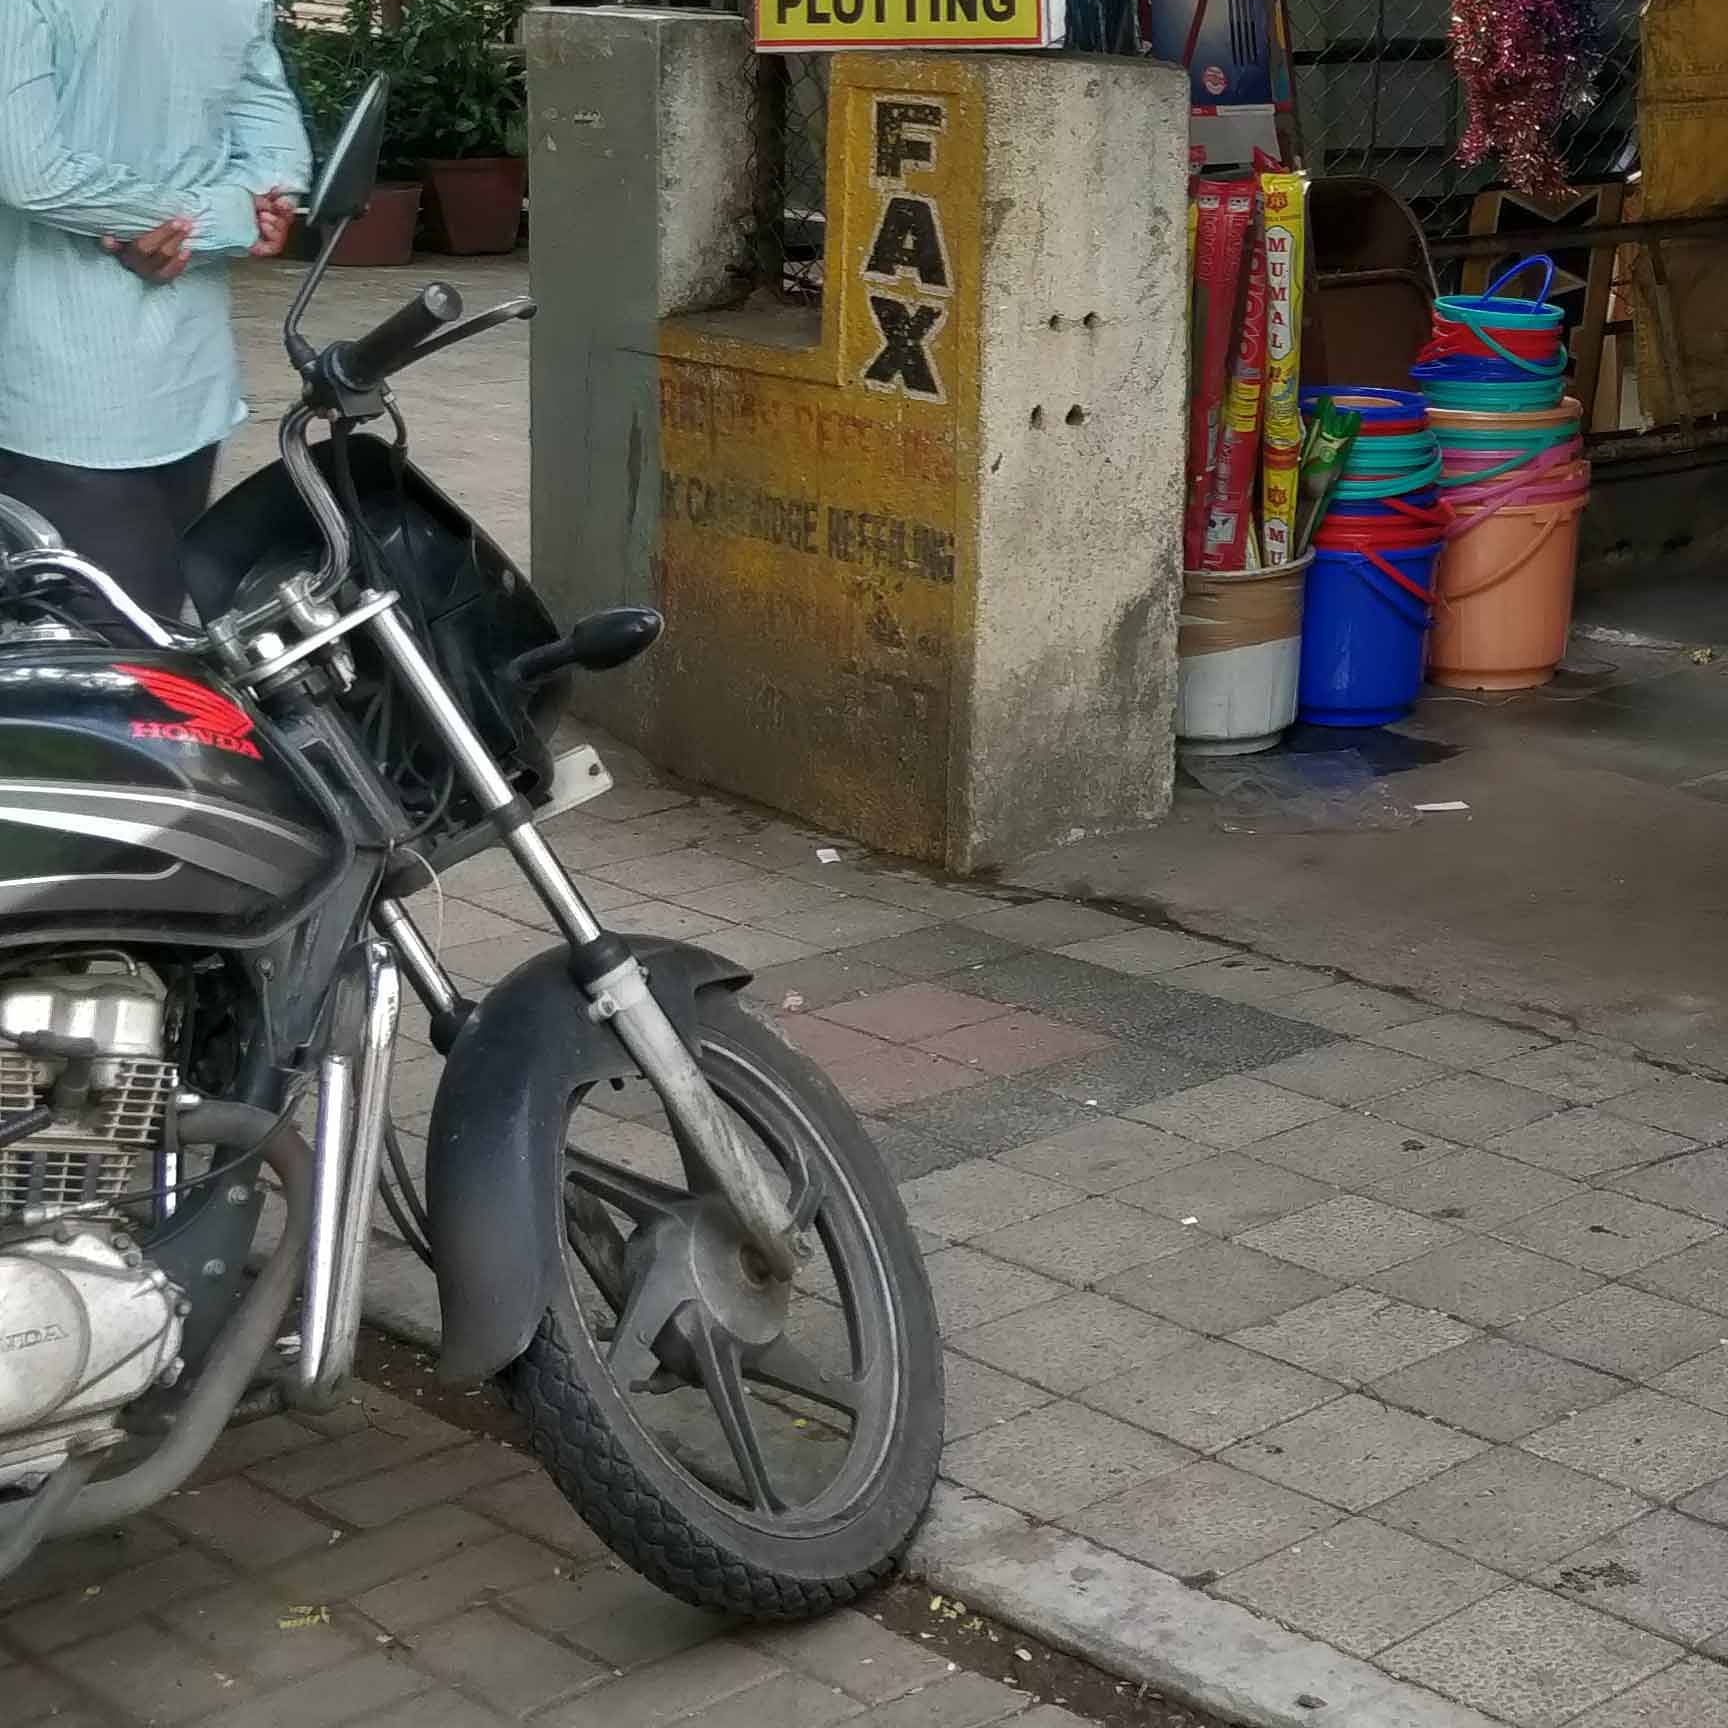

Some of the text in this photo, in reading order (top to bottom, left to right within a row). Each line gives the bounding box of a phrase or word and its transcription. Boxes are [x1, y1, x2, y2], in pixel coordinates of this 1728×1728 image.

[860, 97, 953, 401] FAX
[1267, 236, 1289, 350] MUMAL
[129, 720, 263, 760] HONDA
